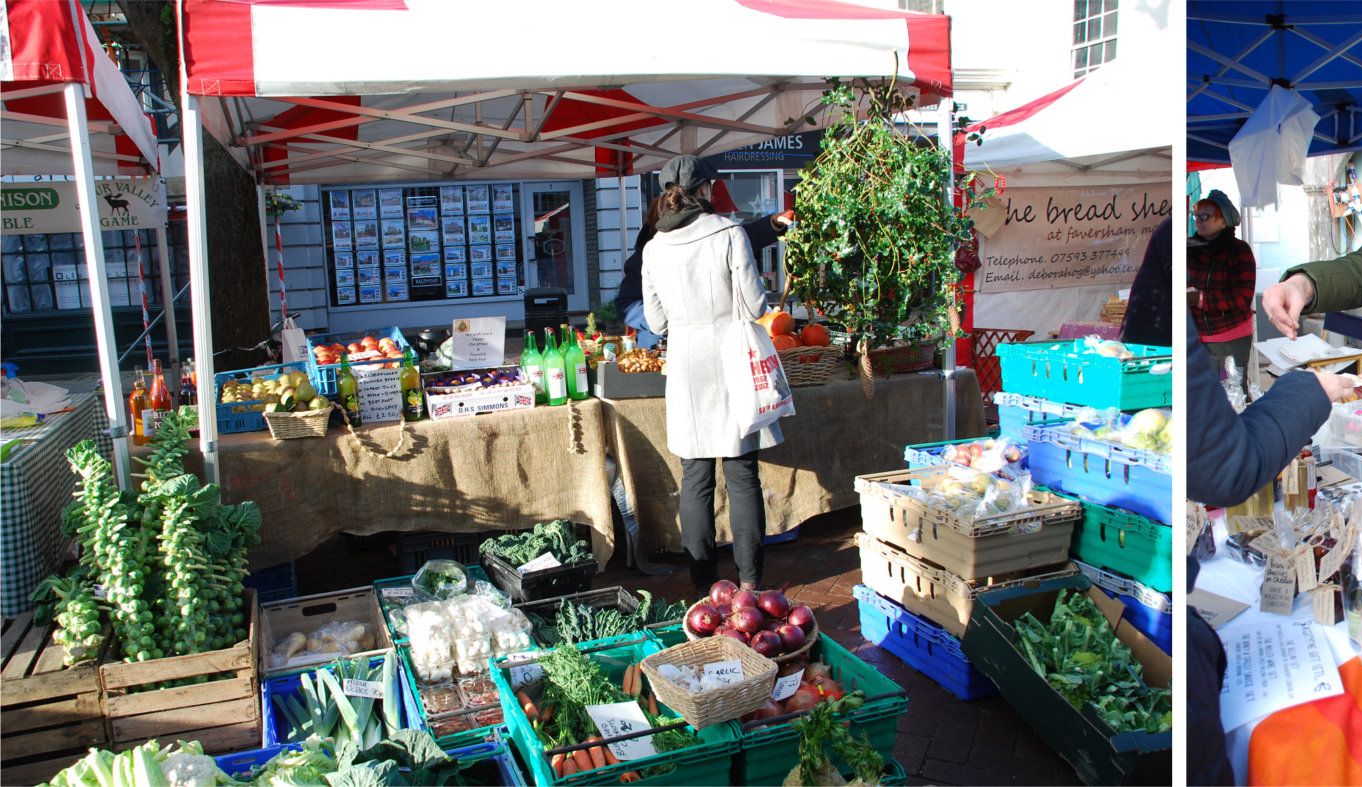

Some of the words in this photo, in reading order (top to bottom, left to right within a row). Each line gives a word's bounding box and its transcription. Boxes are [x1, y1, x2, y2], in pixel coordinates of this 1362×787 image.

[724, 151, 784, 161] HAIRDRESSING
[115, 182, 160, 208] VALLEY
[1001, 196, 1037, 226] he
[1046, 194, 1122, 224] bread
[100, 216, 140, 228] GAME
[1047, 230, 1061, 241] at
[1066, 223, 1135, 244] faversham
[1050, 250, 1087, 263] 07593
[478, 402, 509, 412] SIMMONS
